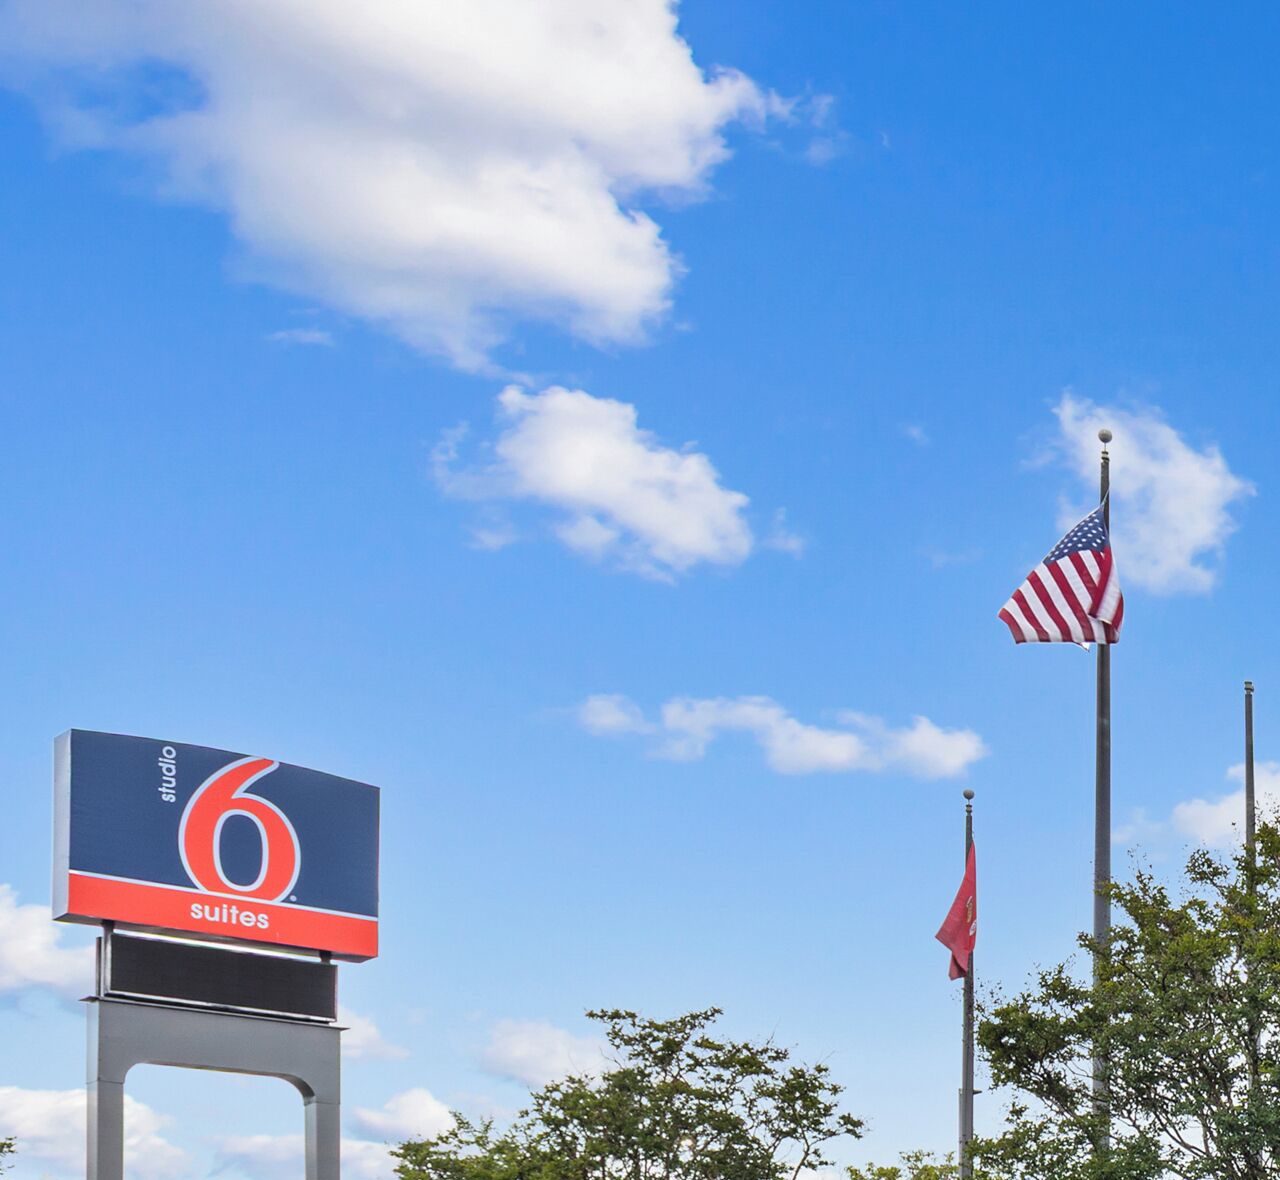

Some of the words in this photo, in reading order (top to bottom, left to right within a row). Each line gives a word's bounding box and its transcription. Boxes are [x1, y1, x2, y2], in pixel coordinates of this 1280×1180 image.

[159, 746, 177, 802] studio
[179, 755, 301, 902] 6
[190, 902, 269, 929] suites
